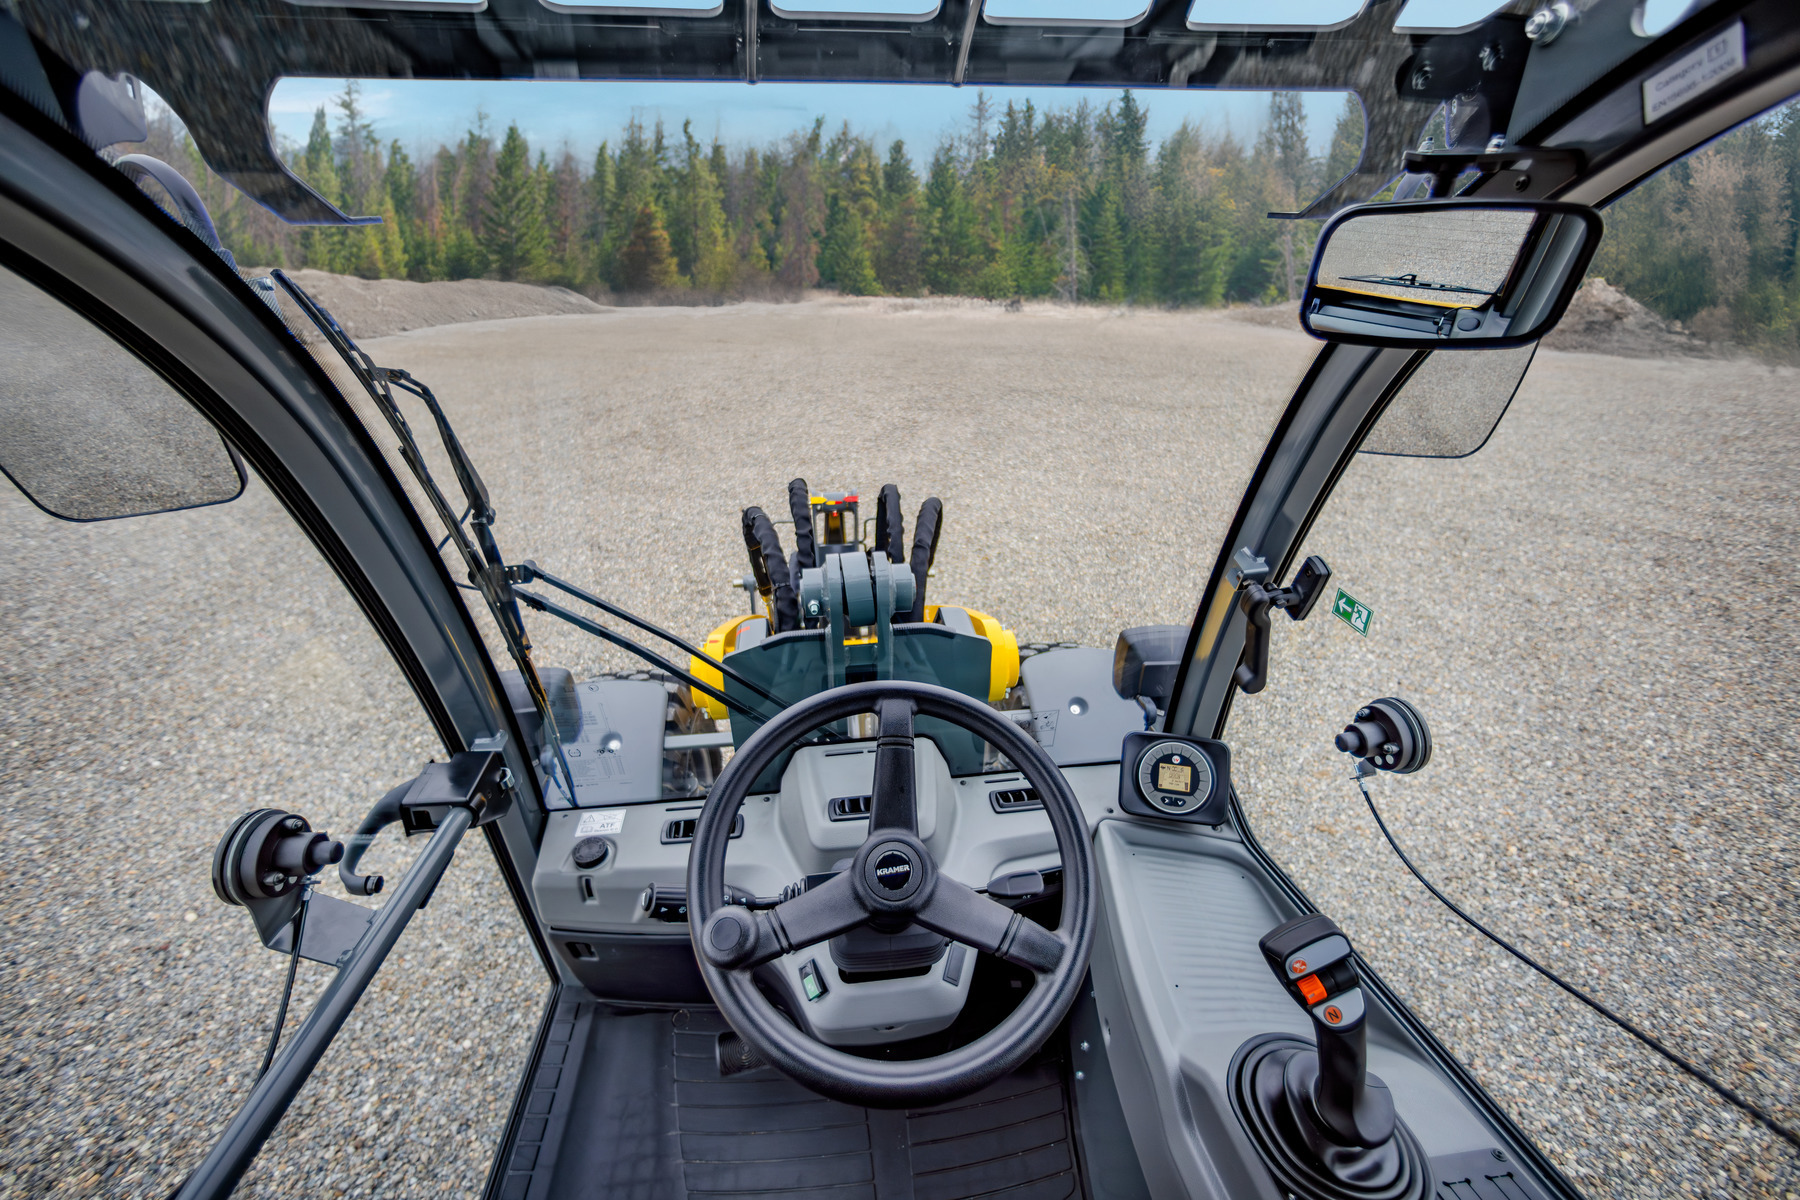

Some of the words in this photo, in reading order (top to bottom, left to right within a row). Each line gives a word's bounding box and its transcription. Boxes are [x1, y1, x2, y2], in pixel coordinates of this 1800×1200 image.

[599, 821, 615, 829] ATF
[876, 864, 911, 876] KRAMER
[1328, 1009, 1340, 1022] N
